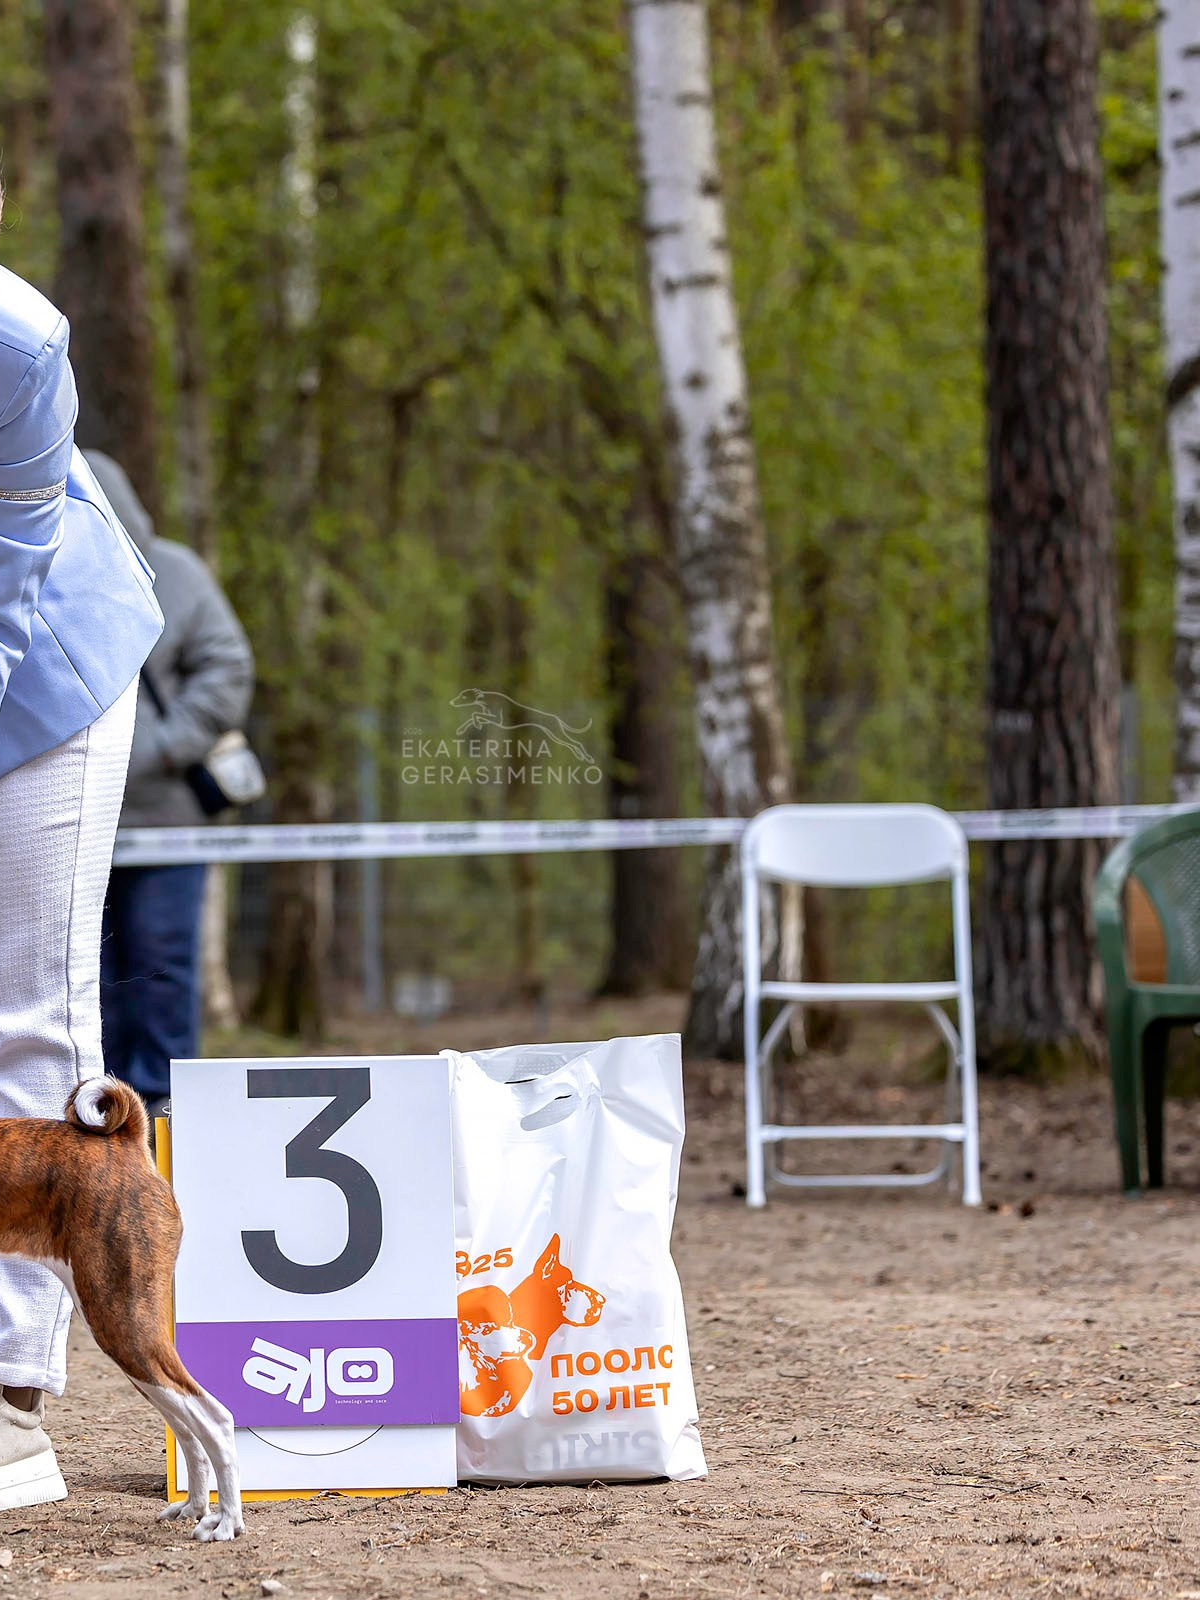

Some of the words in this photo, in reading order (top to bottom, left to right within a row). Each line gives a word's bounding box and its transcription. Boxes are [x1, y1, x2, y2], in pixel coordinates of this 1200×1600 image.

[240, 1067, 383, 1294] 3
[552, 1388, 599, 1416] 50
[605, 1382, 671, 1411] ЛЕТ
